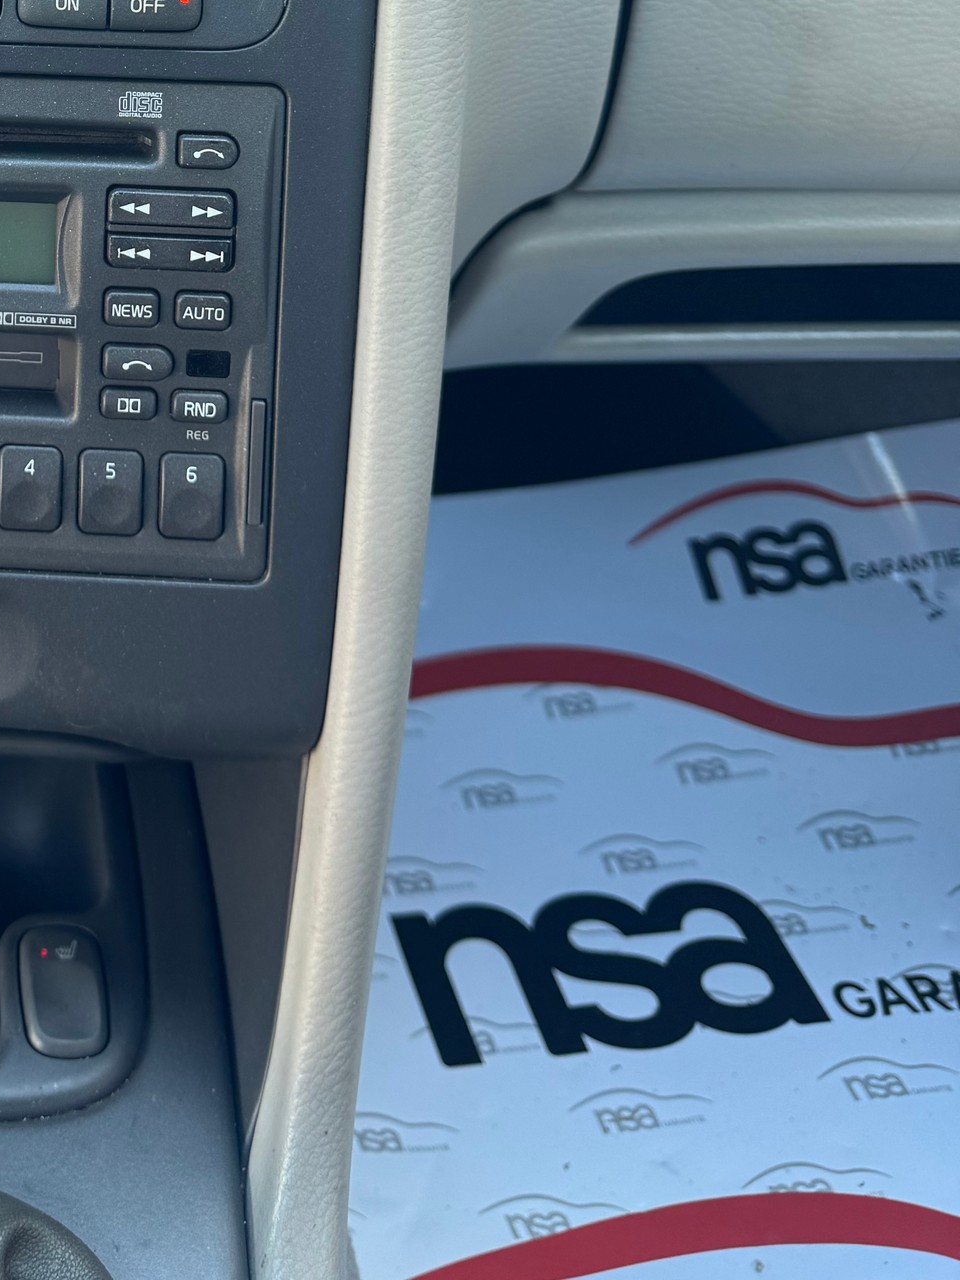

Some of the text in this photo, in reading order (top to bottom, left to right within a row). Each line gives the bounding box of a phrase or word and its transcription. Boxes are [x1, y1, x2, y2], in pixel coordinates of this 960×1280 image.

[111, 303, 153, 319] NEWS
[182, 306, 225, 321] AUTO
[19, 315, 73, 326] DOLBY B NR
[183, 401, 217, 418] RND
[186, 429, 209, 440] REG
[24, 458, 36, 476] 4
[105, 462, 117, 480] 5
[186, 465, 198, 483] 6
[686, 518, 960, 602] nsa GARANTIE
[390, 880, 832, 1067] nsa
[843, 1072, 909, 1102] nsa
[594, 1104, 659, 1135] nsa
